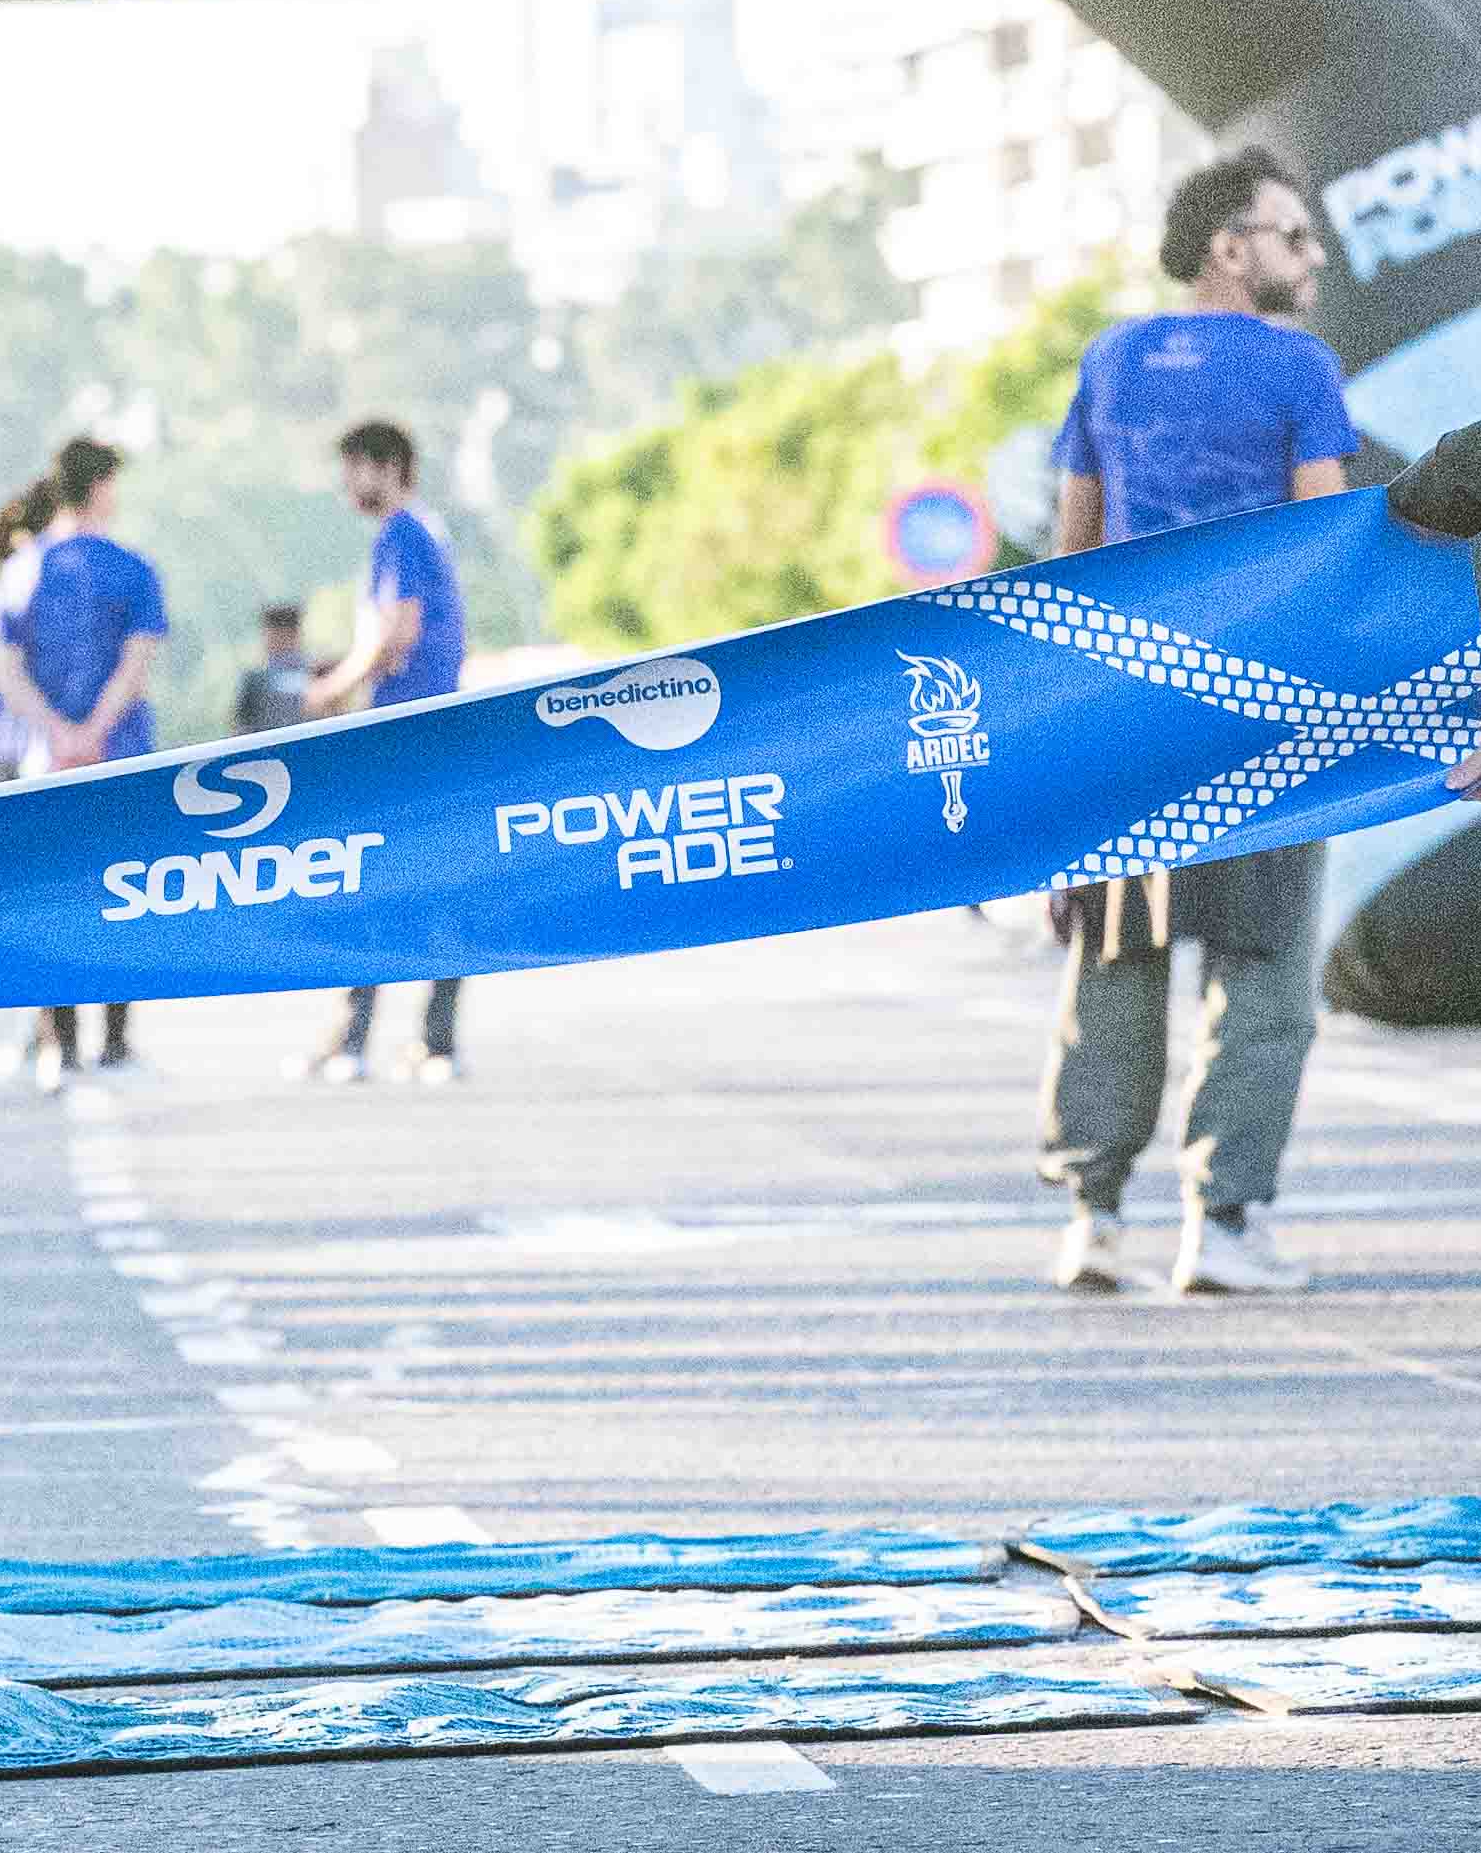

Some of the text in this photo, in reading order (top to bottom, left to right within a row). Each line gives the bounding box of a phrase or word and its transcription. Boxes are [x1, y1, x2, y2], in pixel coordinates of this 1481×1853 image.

[546, 677, 712, 714] benedictino
[907, 732, 990, 769] ARDEC
[496, 772, 786, 854] POWER
